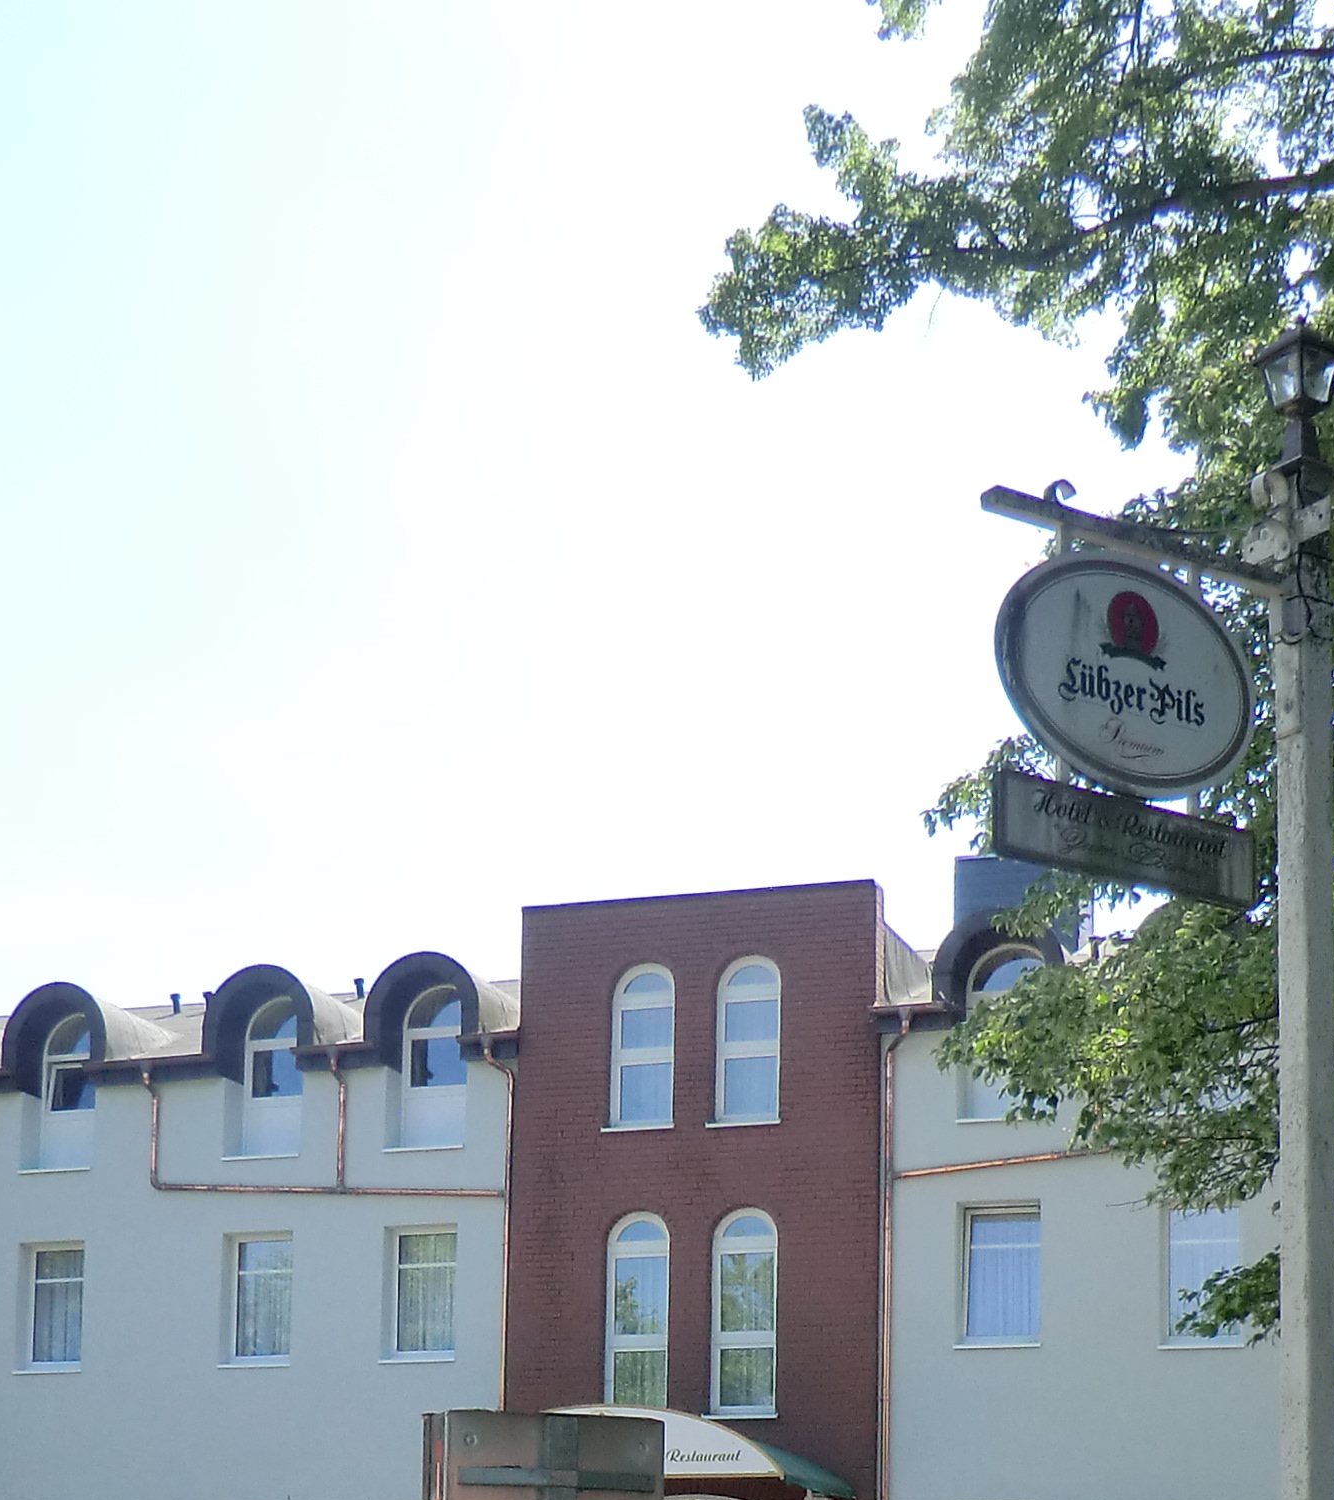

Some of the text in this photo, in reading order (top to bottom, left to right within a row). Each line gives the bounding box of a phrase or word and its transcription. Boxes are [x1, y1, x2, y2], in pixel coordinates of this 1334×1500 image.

[1058, 657, 1205, 725] Lübzer Pils
[666, 1448, 741, 1462] Restaurant
